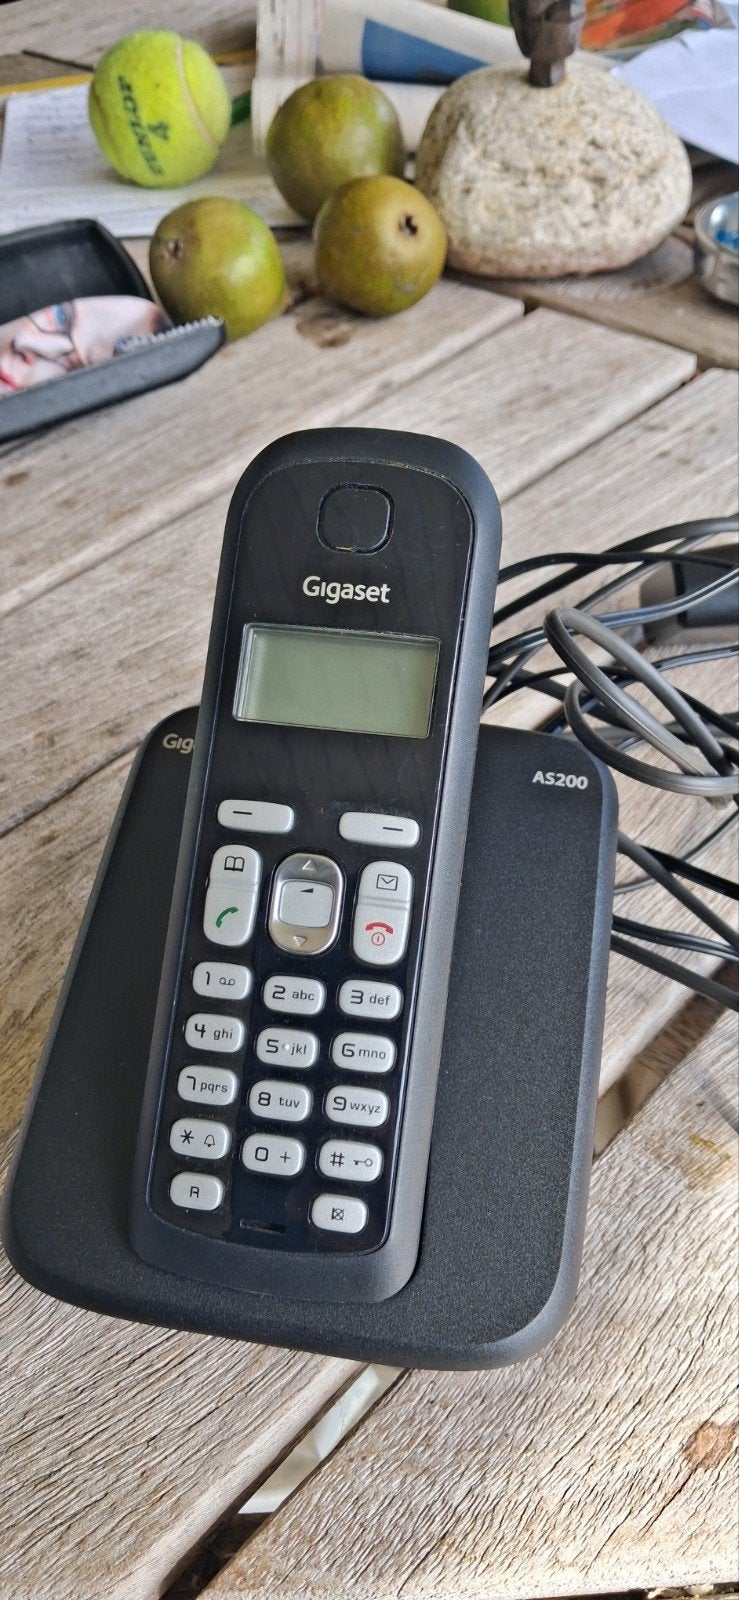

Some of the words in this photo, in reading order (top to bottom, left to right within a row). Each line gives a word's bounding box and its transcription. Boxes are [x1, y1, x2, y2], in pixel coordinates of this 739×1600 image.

[302, 575, 391, 604] Gigaset
[163, 733, 195, 754] Gig
[532, 770, 588, 789] AS200
[272, 985, 285, 1000] 2
[292, 989, 315, 1001] abc
[350, 989, 364, 1005] 3
[369, 994, 391, 1006] def
[194, 1023, 206, 1038] 4
[213, 1028, 233, 1040] ghi
[266, 1039, 279, 1054] 5
[290, 1042, 307, 1056] jkl
[341, 1043, 356, 1058] 6
[358, 1048, 387, 1060] mno
[186, 1076, 197, 1091] 7
[200, 1081, 228, 1093] pqrs
[257, 1091, 271, 1107] 8
[279, 1096, 300, 1108] tuv
[332, 1096, 347, 1111] 9
[350, 1102, 381, 1115] wxyz
[330, 1152, 345, 1168] #
[189, 1186, 199, 1198] R
